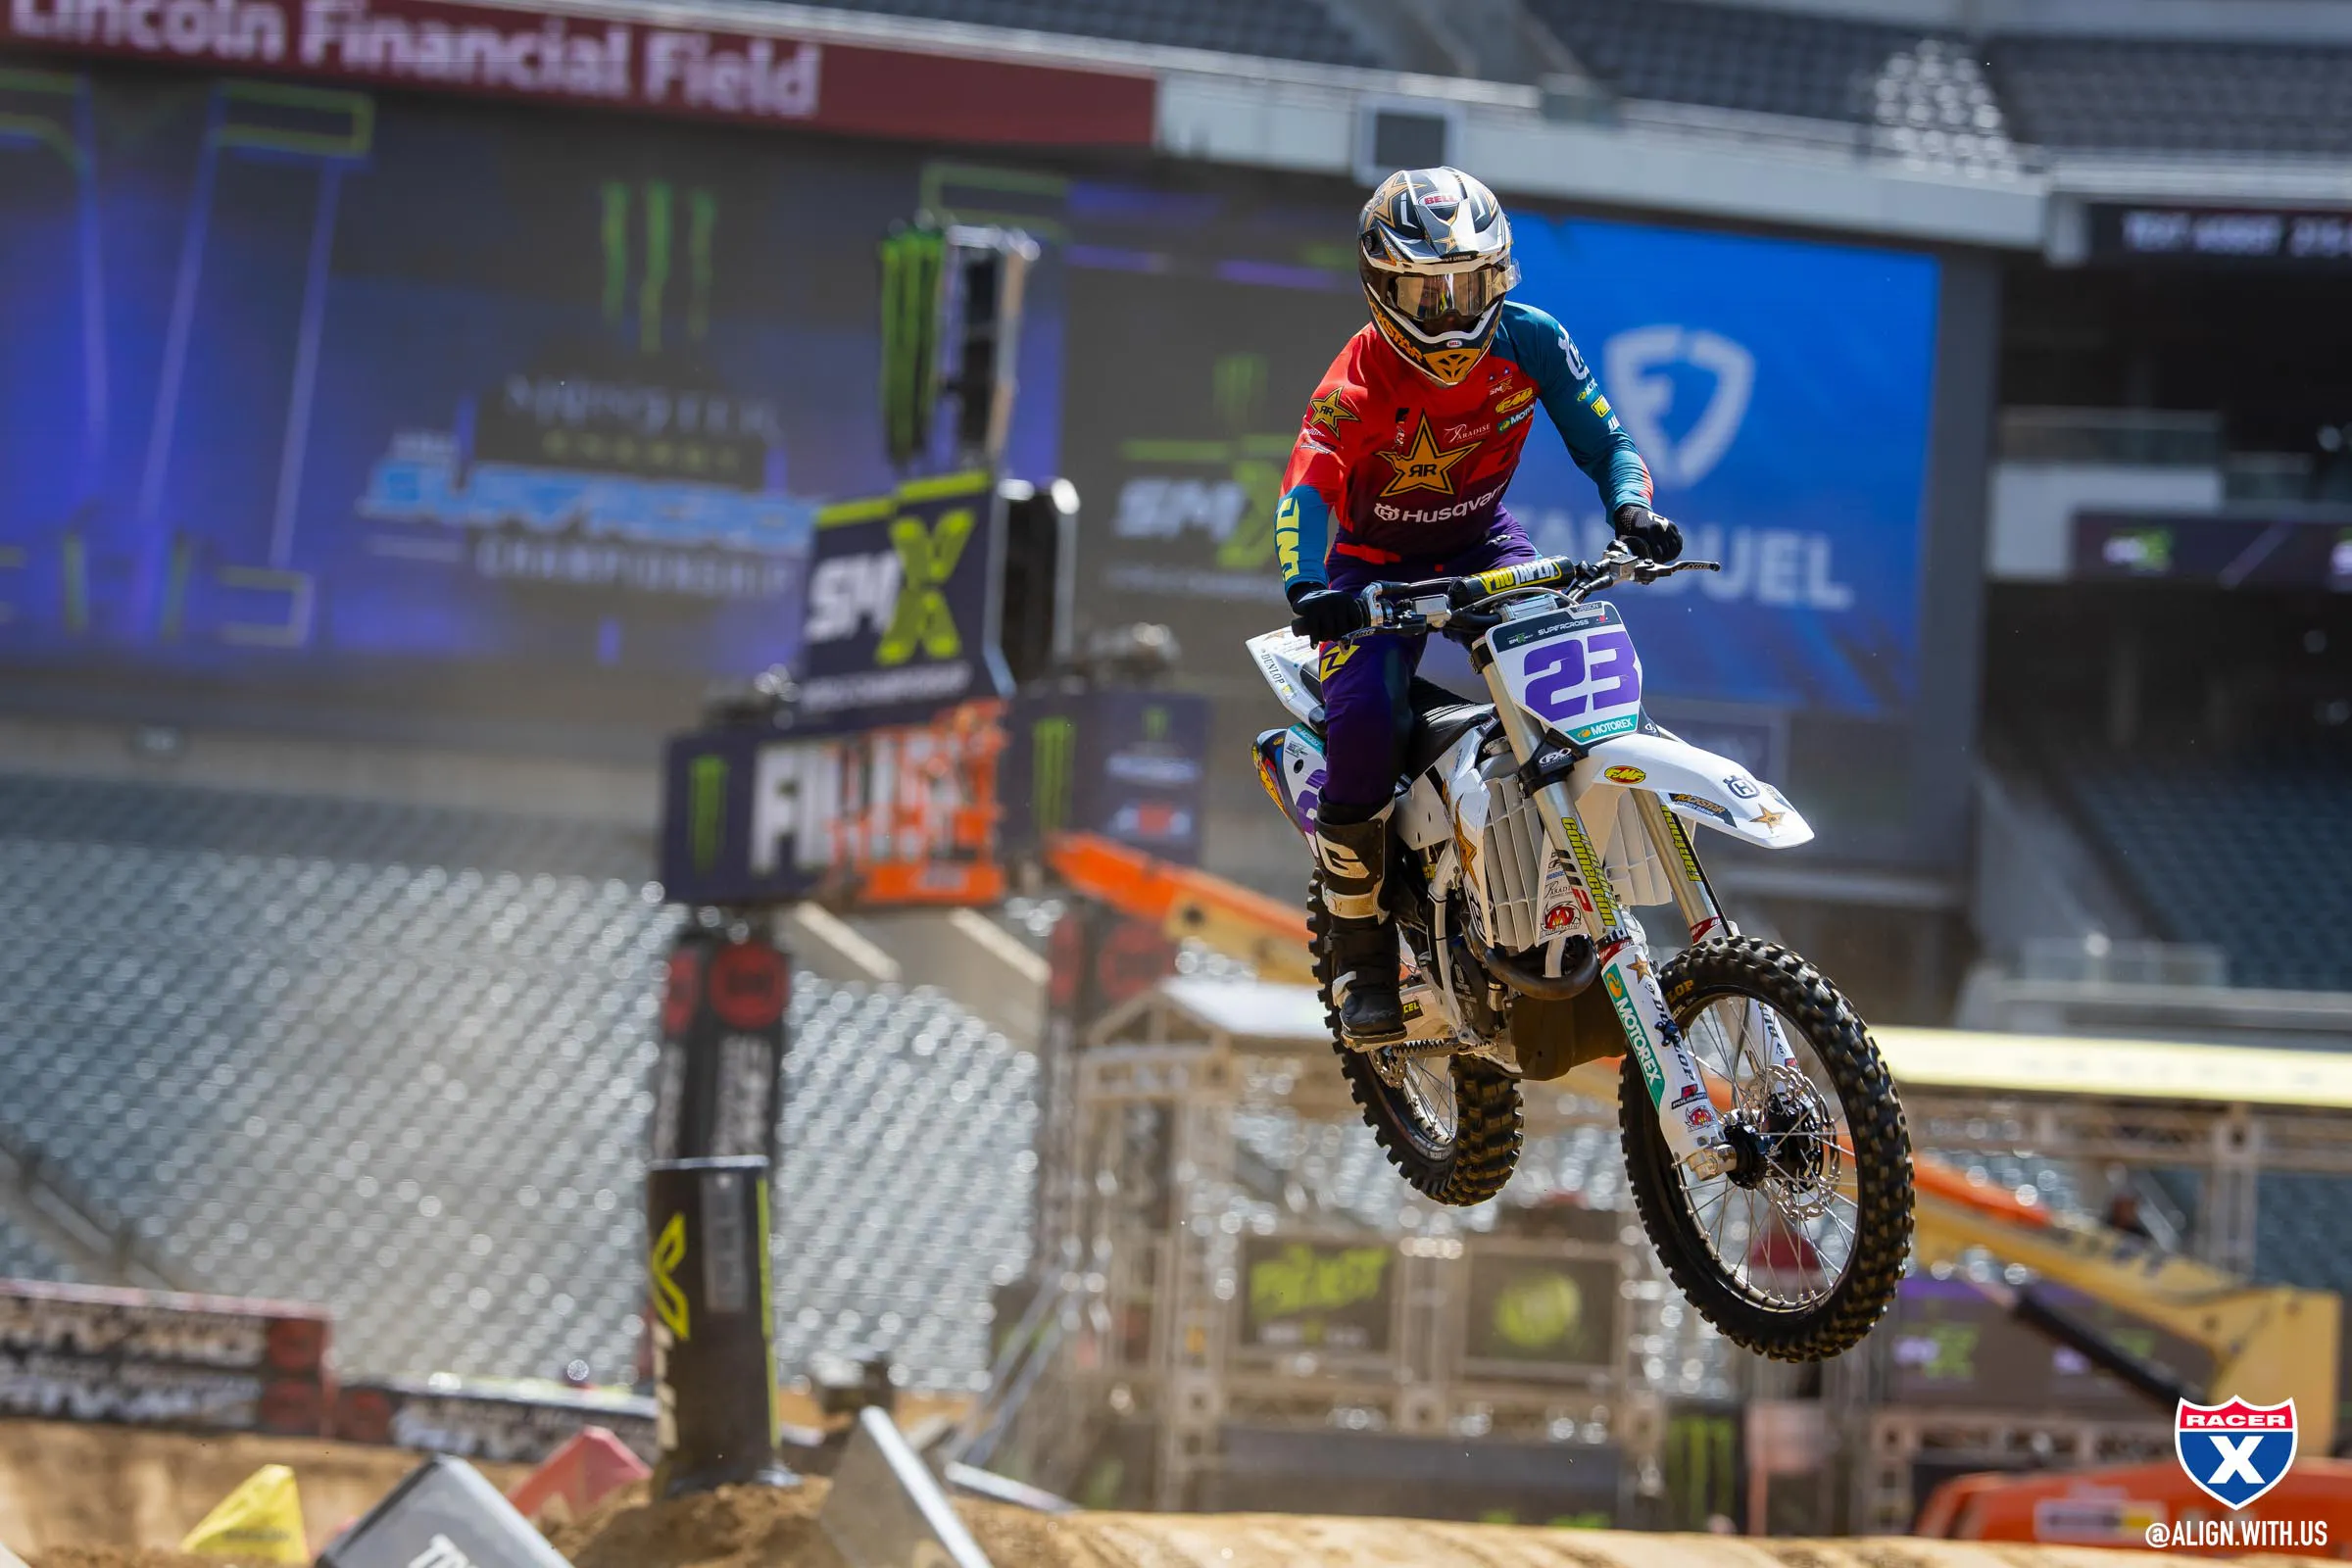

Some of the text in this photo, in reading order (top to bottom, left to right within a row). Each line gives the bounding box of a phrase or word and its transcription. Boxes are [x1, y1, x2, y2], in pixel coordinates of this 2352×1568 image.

[11, 0, 821, 119] Lincoln Financial Field
[1424, 195, 1458, 206] BELL
[804, 508, 976, 665] SMX
[1538, 619, 1590, 636] SUPERCROSS
[1261, 654, 1286, 684] DUNLOP
[1524, 631, 1640, 722] 23
[1591, 717, 1633, 735] MOTOREX
[1605, 766, 1646, 783] FMF
[1402, 1003, 1419, 1013] CEL
[1616, 997, 1662, 1086] MOTOREX
[1652, 999, 1695, 1081] DULOP
